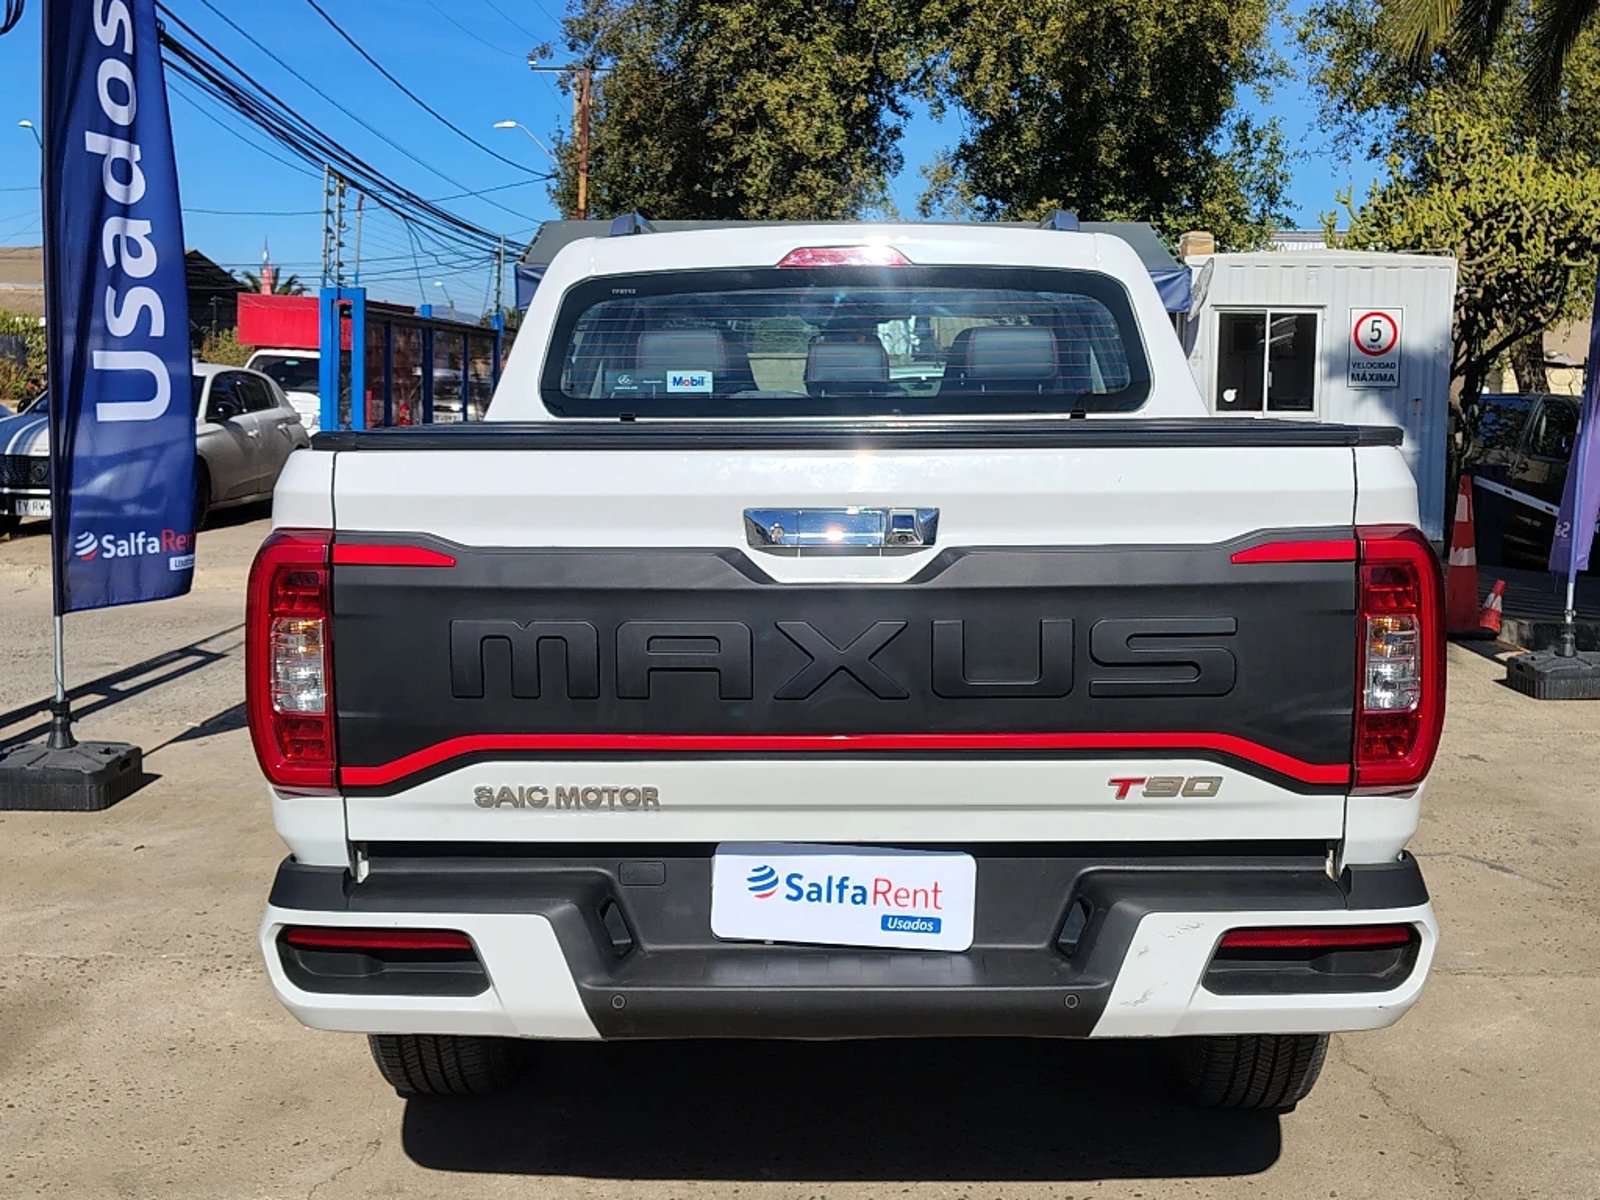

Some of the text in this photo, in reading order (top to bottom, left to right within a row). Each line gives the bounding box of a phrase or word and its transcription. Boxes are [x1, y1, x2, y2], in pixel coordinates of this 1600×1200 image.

[85, 0, 172, 422] Usados
[1370, 319, 1382, 343] 5
[1351, 361, 1396, 370] VELOCIDAD
[1351, 370, 1396, 383] MÁXIMA
[672, 376, 705, 387] Mobil
[449, 615, 1238, 700] MAXUS
[473, 785, 661, 811] SAIC MOTOR
[1107, 775, 1224, 800] T90
[785, 872, 943, 910] SalfaRent
[887, 916, 934, 932] Usados
